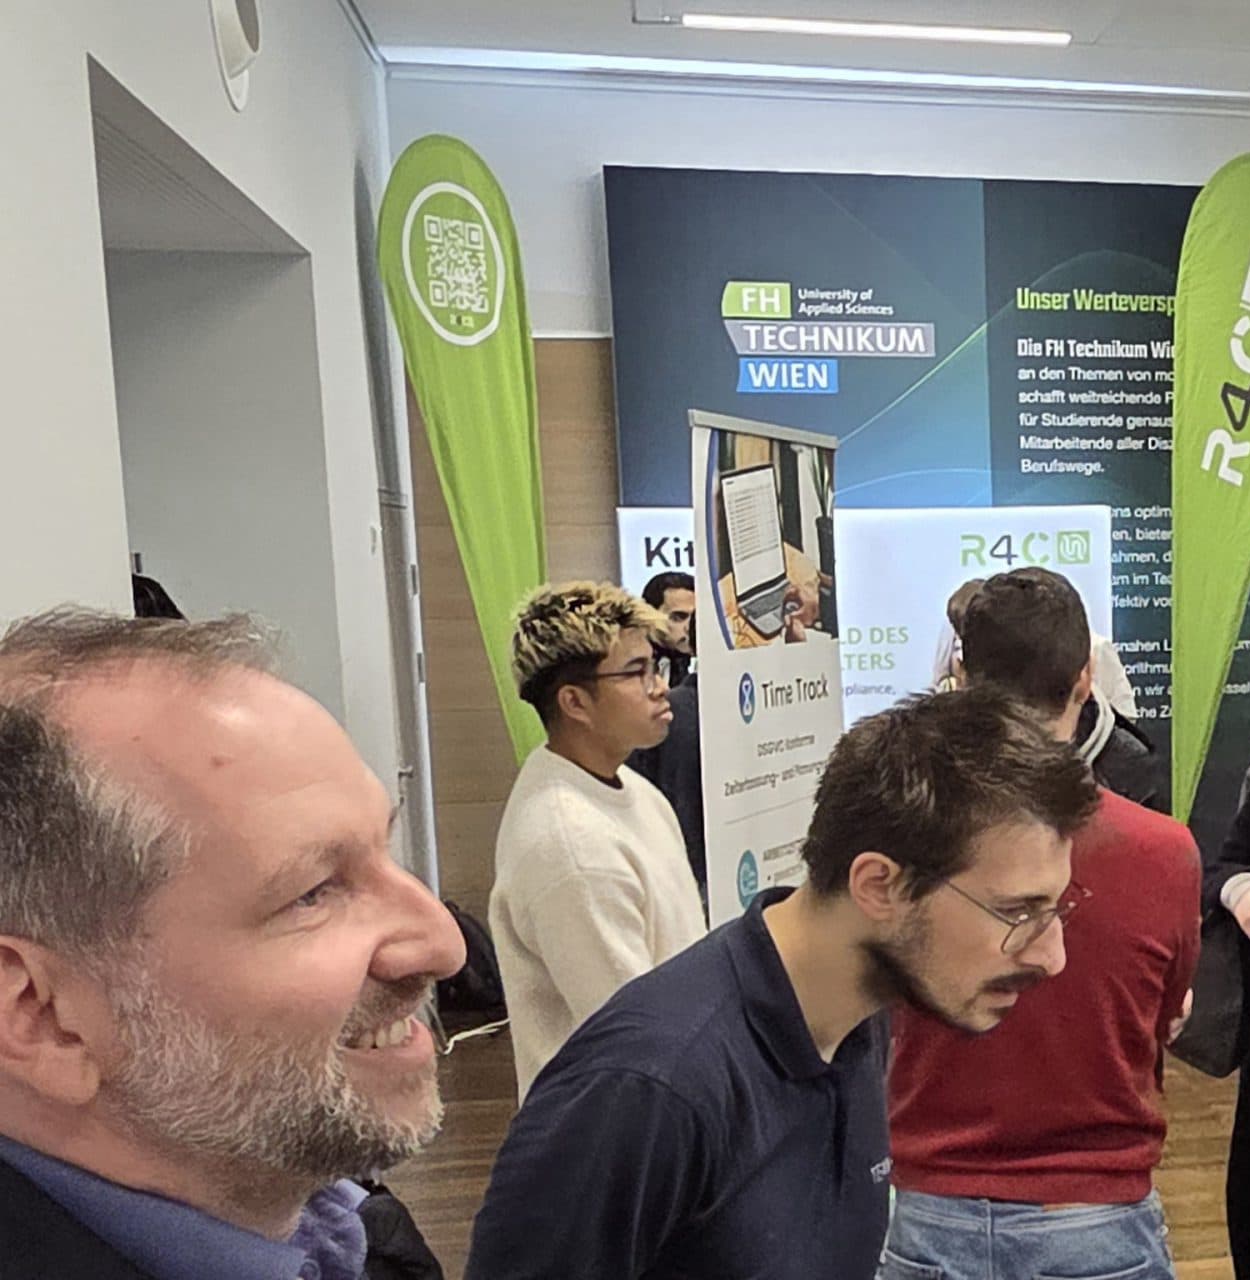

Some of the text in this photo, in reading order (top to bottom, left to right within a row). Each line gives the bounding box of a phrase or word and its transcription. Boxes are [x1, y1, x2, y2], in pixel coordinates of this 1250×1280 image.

[741, 287, 781, 313] FH
[797, 288, 874, 304] University of
[1016, 287, 1071, 310] Unser
[798, 302, 894, 316] Applied Sciences
[743, 325, 926, 353] TECHNIKUM
[1016, 338, 1043, 357] Die
[1045, 339, 1065, 357] FH
[1067, 339, 1148, 359] Technikum
[748, 362, 829, 389] WIEN
[1018, 368, 1036, 380] an
[1039, 366, 1066, 381] den
[1068, 366, 1124, 381] Themen
[1126, 369, 1150, 382] von
[1018, 389, 1066, 403] schafft
[1068, 389, 1162, 404] weitreichende
[1018, 412, 1039, 427] für
[1041, 412, 1124, 427] Studierende
[1019, 435, 1113, 450] Mitarbeitende
[1116, 436, 1145, 450] aller
[1020, 458, 1105, 476] Berufswege.
[1132, 572, 1150, 585] im
[838, 625, 909, 645] D DES
[841, 653, 895, 672] TERS
[761, 680, 794, 710] Time
[840, 683, 897, 697] pliance,
